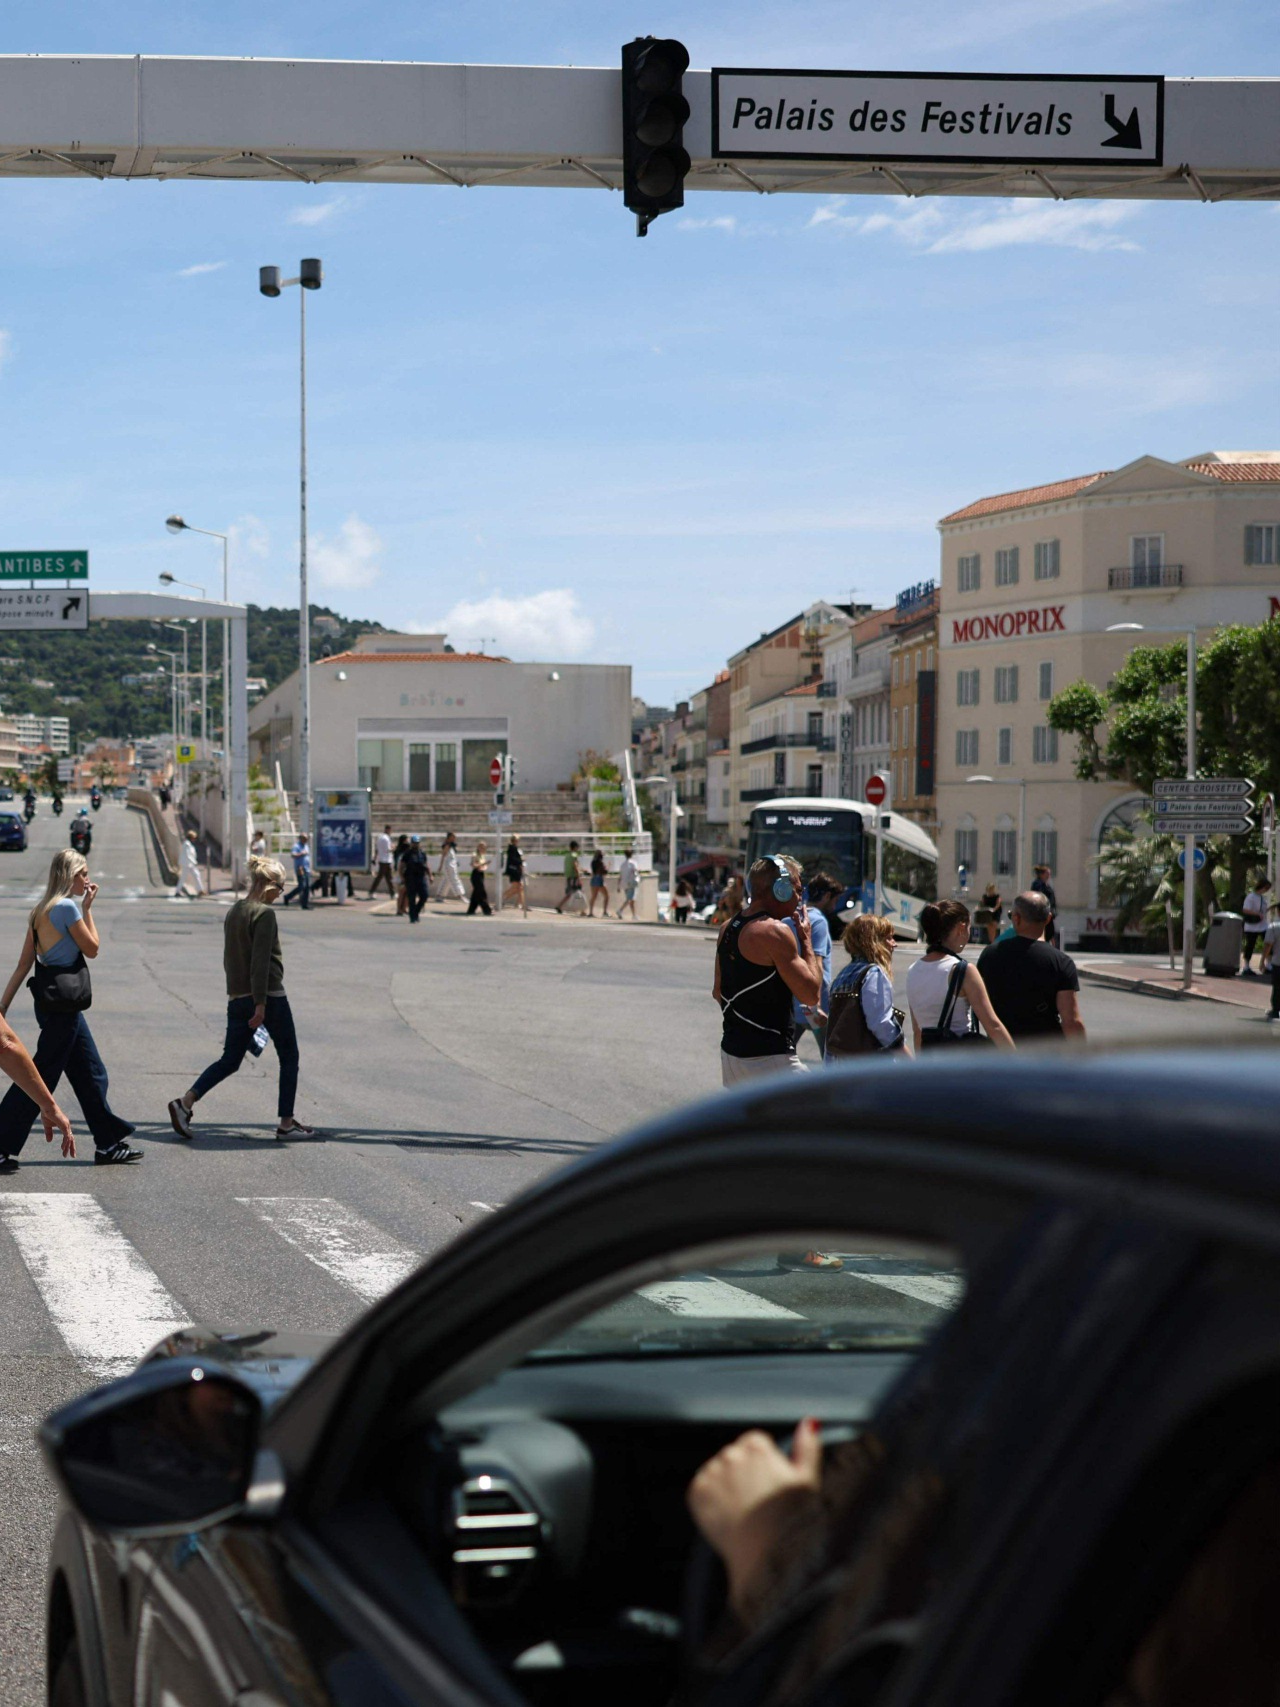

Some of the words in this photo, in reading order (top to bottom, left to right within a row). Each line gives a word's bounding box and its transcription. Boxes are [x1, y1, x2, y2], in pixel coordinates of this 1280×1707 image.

[732, 97, 835, 131] Palais
[849, 101, 906, 133] des
[921, 101, 1073, 136] Festivals
[25, 609, 54, 618] minute
[953, 605, 1067, 644] MONOPRIX
[1157, 785, 1190, 793] CENTRE
[1193, 784, 1243, 792] CROISETTE
[1169, 803, 1191, 811] Palais
[1193, 803, 1206, 811] des
[1208, 803, 1243, 811] Festivals
[1205, 822, 1240, 830] tourisme
